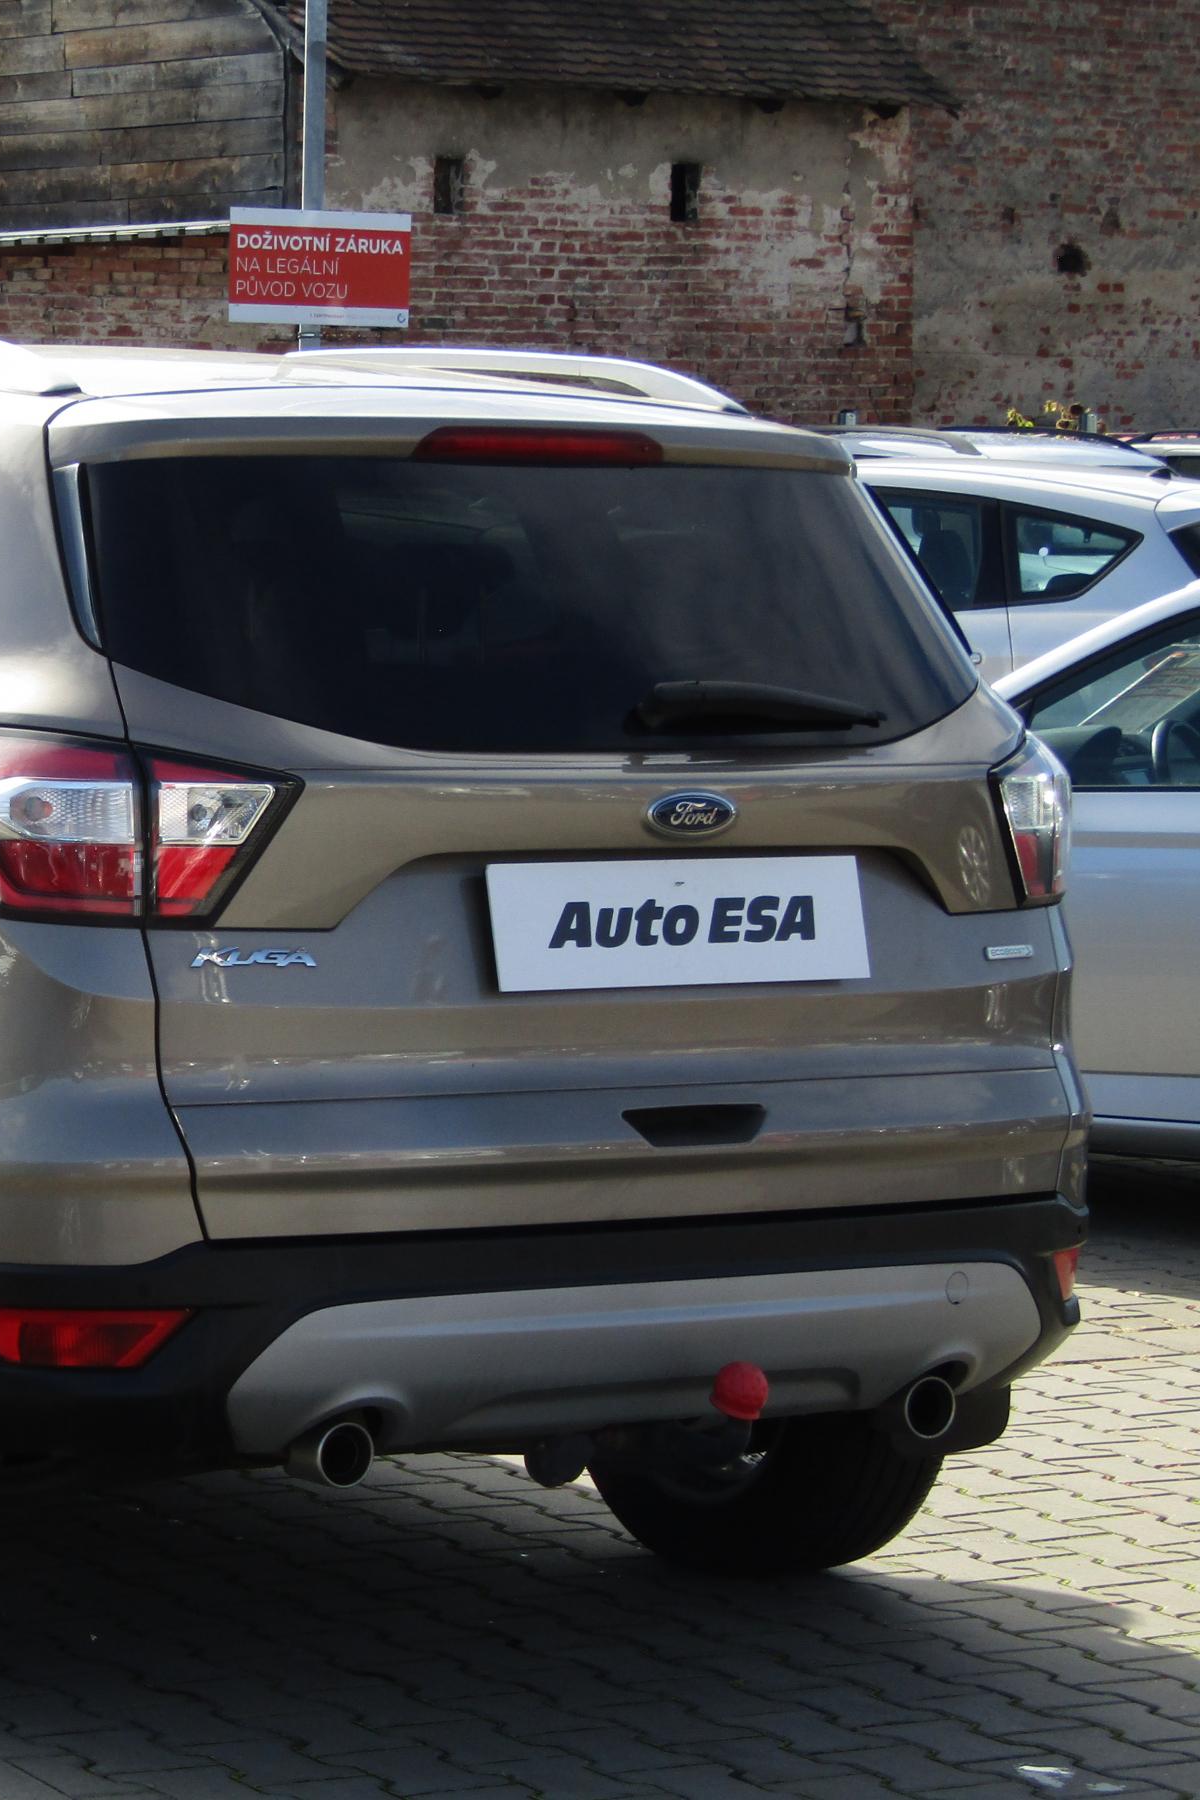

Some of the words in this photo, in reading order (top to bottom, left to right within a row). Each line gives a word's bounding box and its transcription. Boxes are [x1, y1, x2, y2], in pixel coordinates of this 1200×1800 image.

[236, 231, 330, 252] DOŽIVOTNÍ
[335, 234, 403, 255] ZÁRUKA
[236, 257, 260, 273] NA
[266, 256, 339, 275] LEGÁLNÍ
[236, 276, 295, 297] PŮVOD
[302, 282, 348, 299] VOZU
[669, 801, 718, 826] Ford
[548, 898, 699, 949] Auto
[707, 895, 816, 944] ESA
[190, 946, 318, 967] KUGA
